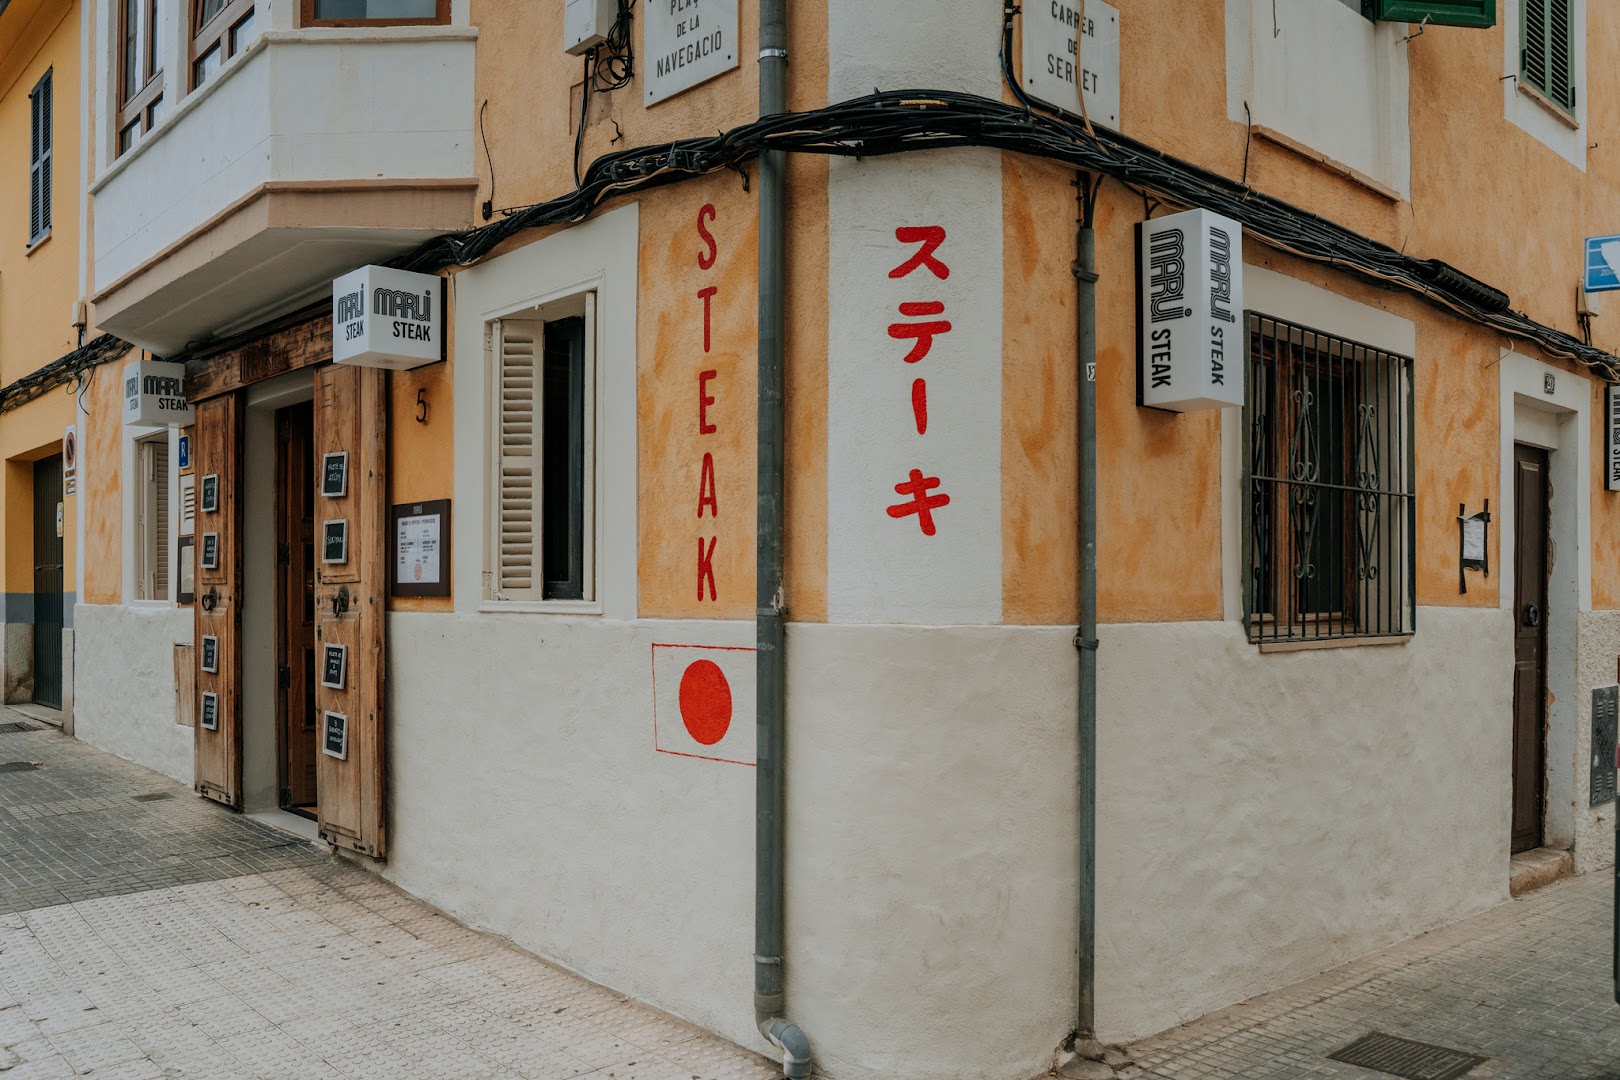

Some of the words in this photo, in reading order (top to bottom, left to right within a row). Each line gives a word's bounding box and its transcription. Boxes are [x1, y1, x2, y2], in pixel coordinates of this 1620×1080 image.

[676, 21, 687, 38] DE
[689, 14, 700, 31] LA
[657, 25, 722, 78] NAVEGACIÓ
[1067, 38, 1077, 55] DE
[1047, 53, 1097, 94] SERET
[346, 320, 364, 341] STEAK
[393, 321, 431, 342] STEAK
[1151, 328, 1171, 389] STEAK
[1211, 325, 1224, 386] STEAK
[886, 225, 952, 536] ステーキ
[158, 397, 188, 411] STEAK
[416, 388, 426, 423] 5
[697, 203, 718, 602] STEAK
[181, 441, 186, 458] R
